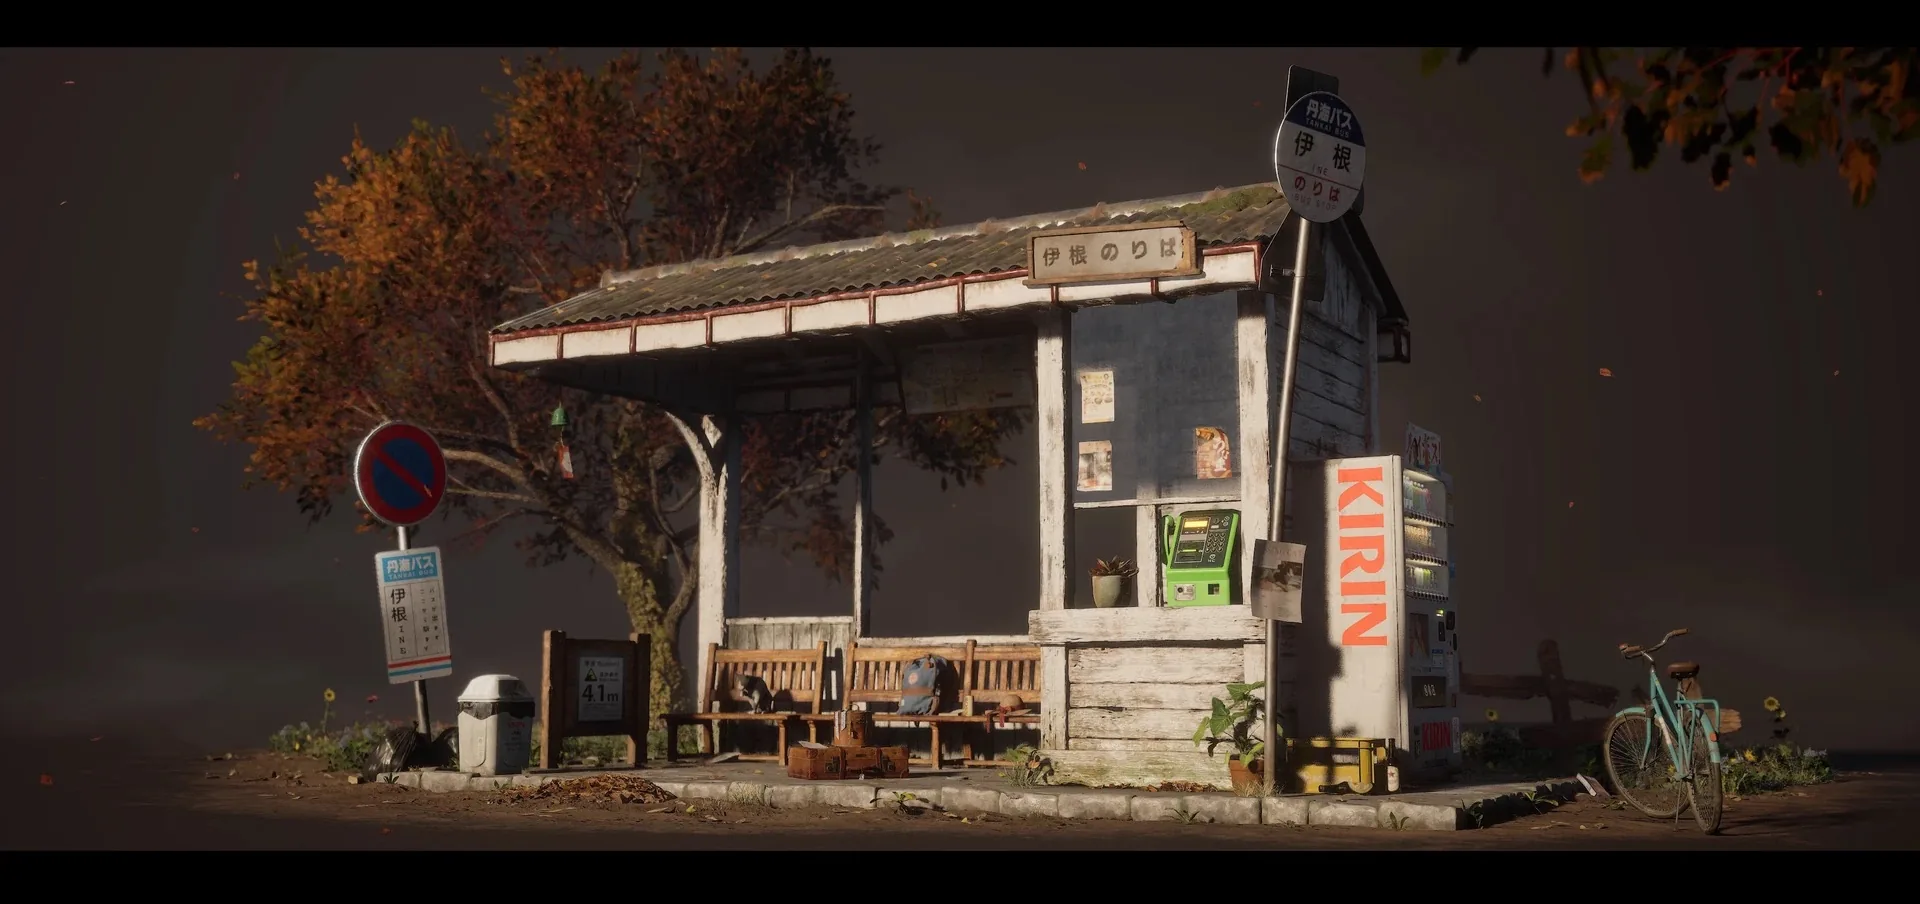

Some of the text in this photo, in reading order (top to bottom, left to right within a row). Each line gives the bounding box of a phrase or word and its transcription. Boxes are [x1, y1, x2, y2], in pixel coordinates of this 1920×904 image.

[1306, 99, 1352, 130] 丹海バス
[1306, 117, 1332, 133] TANKAI
[1294, 130, 1352, 172] 伊根
[386, 555, 434, 574] 丹海バス
[1337, 466, 1388, 646] KIRIN
[1422, 721, 1451, 751] KIRIN
